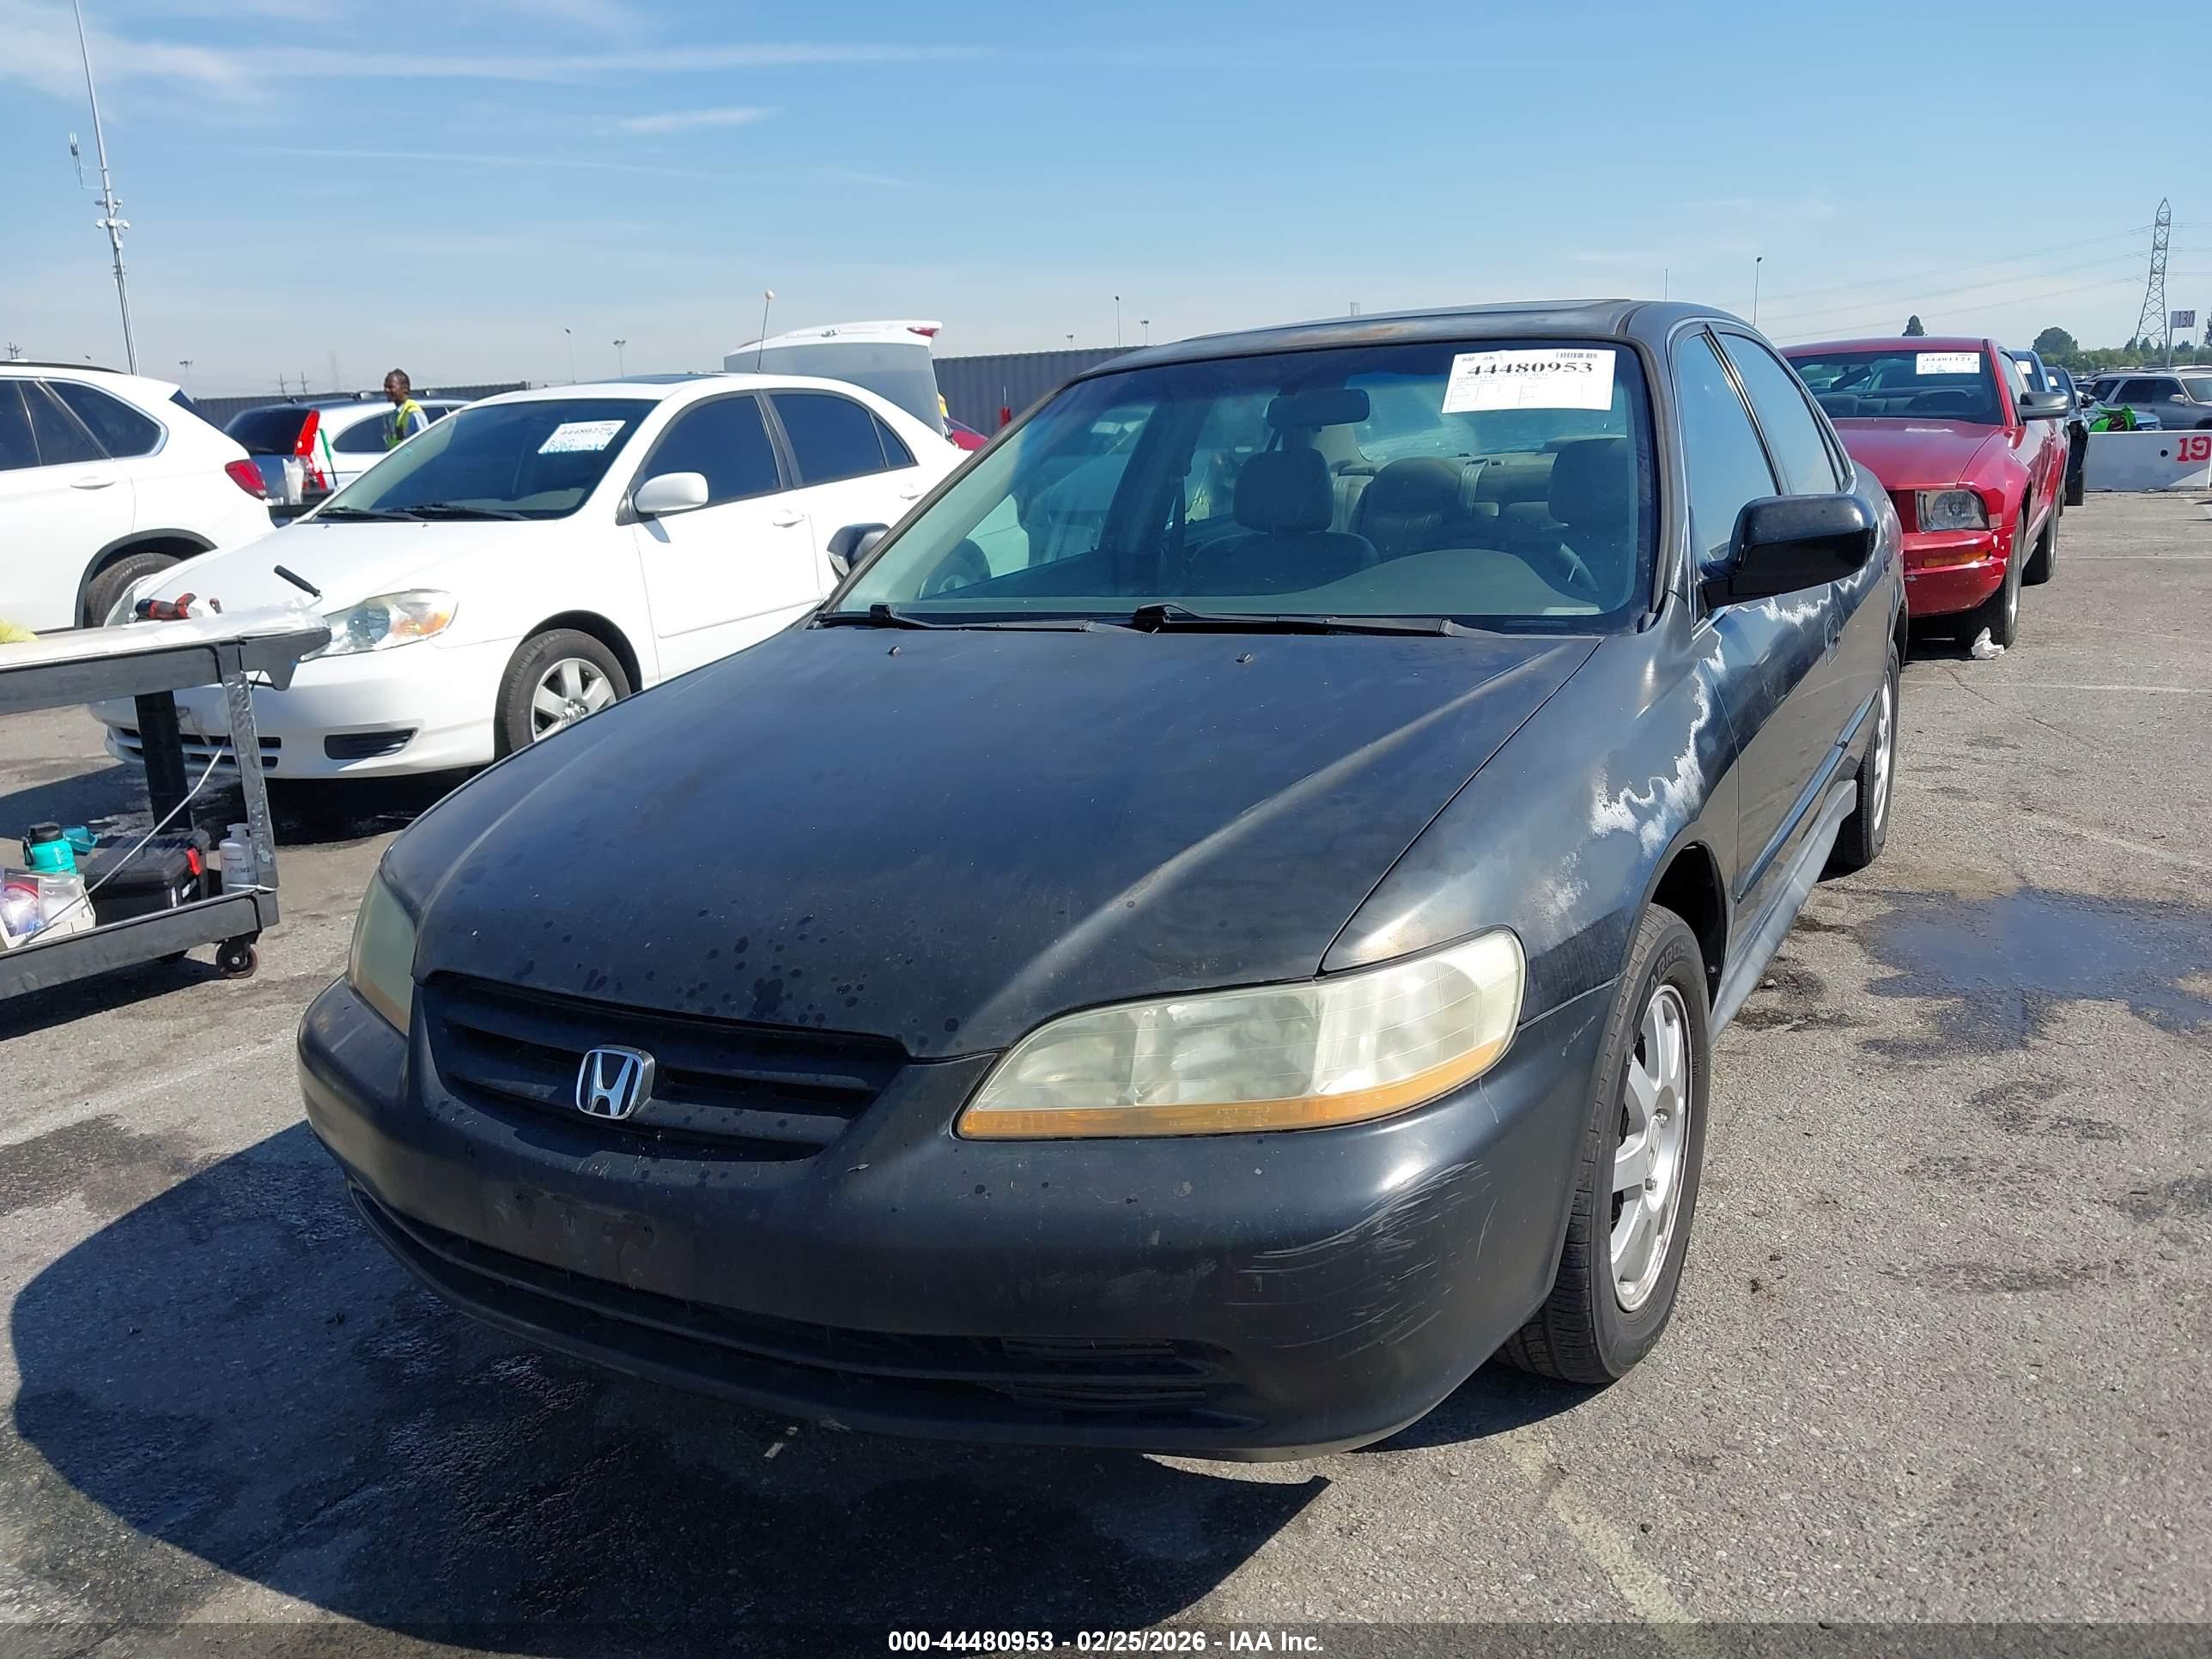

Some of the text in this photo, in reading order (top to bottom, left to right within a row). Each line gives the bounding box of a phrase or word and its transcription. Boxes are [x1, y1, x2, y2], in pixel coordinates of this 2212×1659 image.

[2178, 310, 2196, 327] 130
[1467, 362, 1593, 375] 44480953
[2177, 436, 2212, 461] 19
